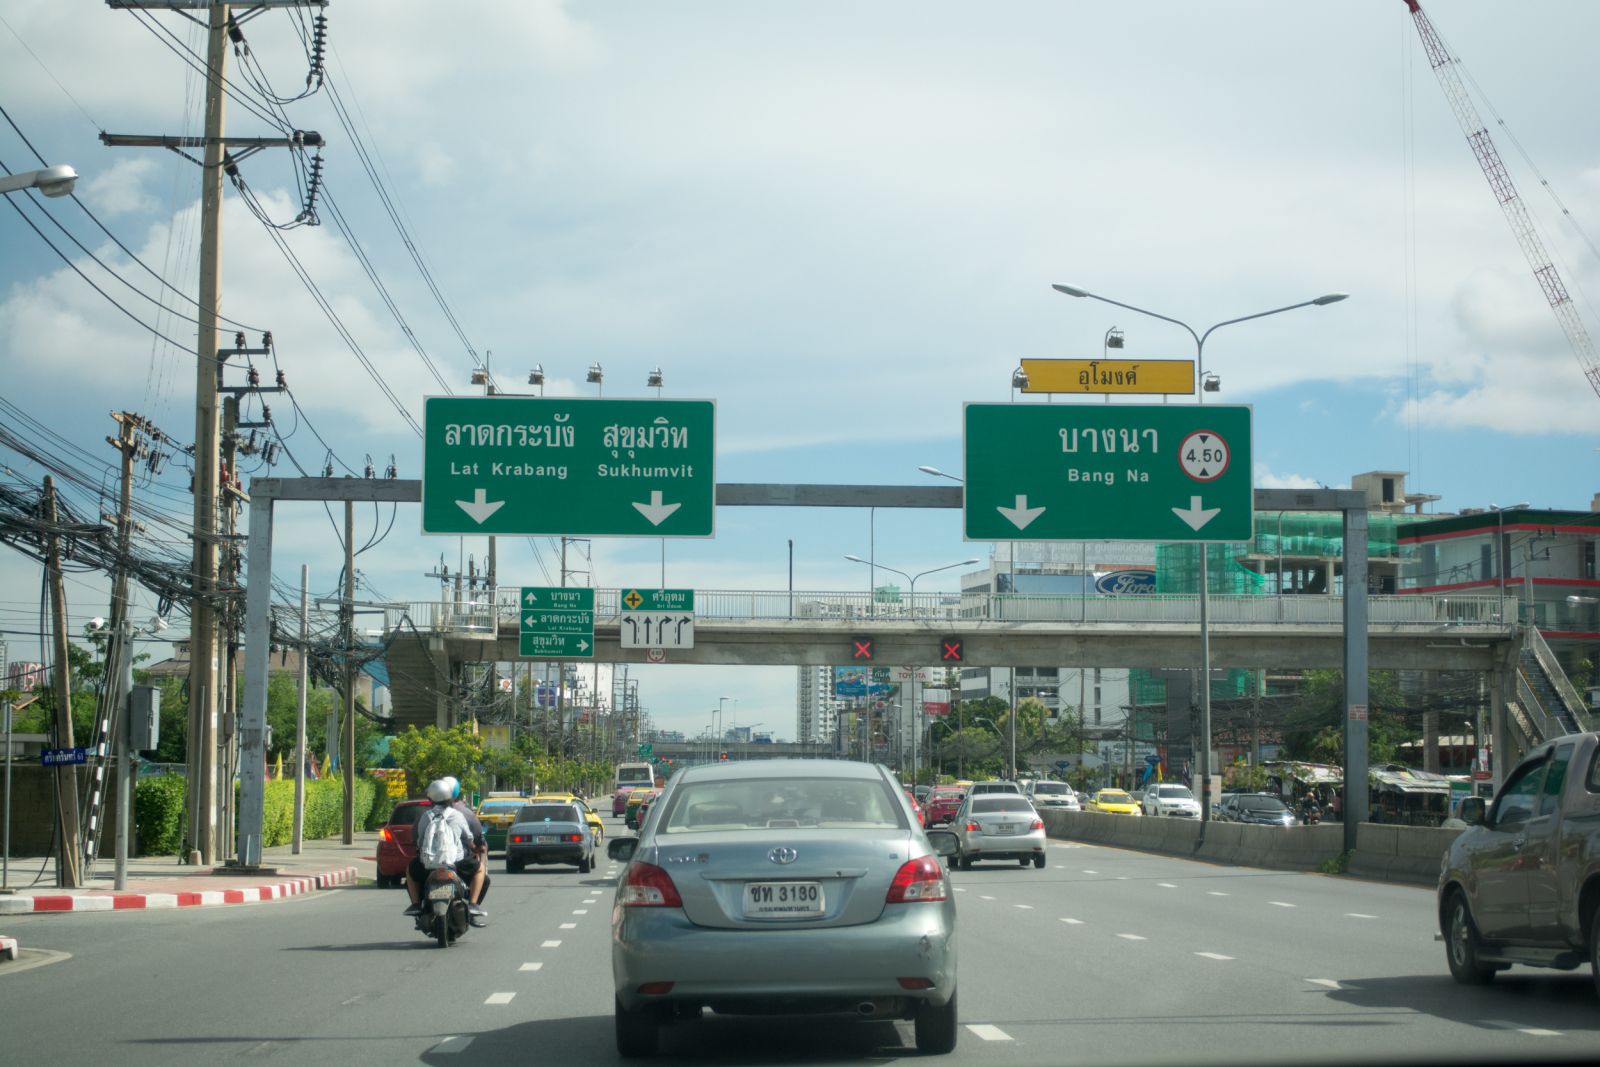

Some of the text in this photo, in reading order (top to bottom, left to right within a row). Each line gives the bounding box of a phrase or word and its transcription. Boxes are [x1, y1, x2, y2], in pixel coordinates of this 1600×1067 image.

[1078, 361, 1140, 391] อุโมงค์
[445, 413, 688, 458] ลาดกระบัง สุขุมวิท
[1058, 427, 1159, 454] บางนา
[1186, 449, 1223, 463] 4.50
[450, 462, 693, 480] Lat Krabang Sukhumvit
[1068, 468, 1150, 485] Bang Na
[551, 591, 581, 601] บางนา
[540, 612, 590, 624] ลาดกระบัง
[532, 634, 565, 649] สุขุมวิท
